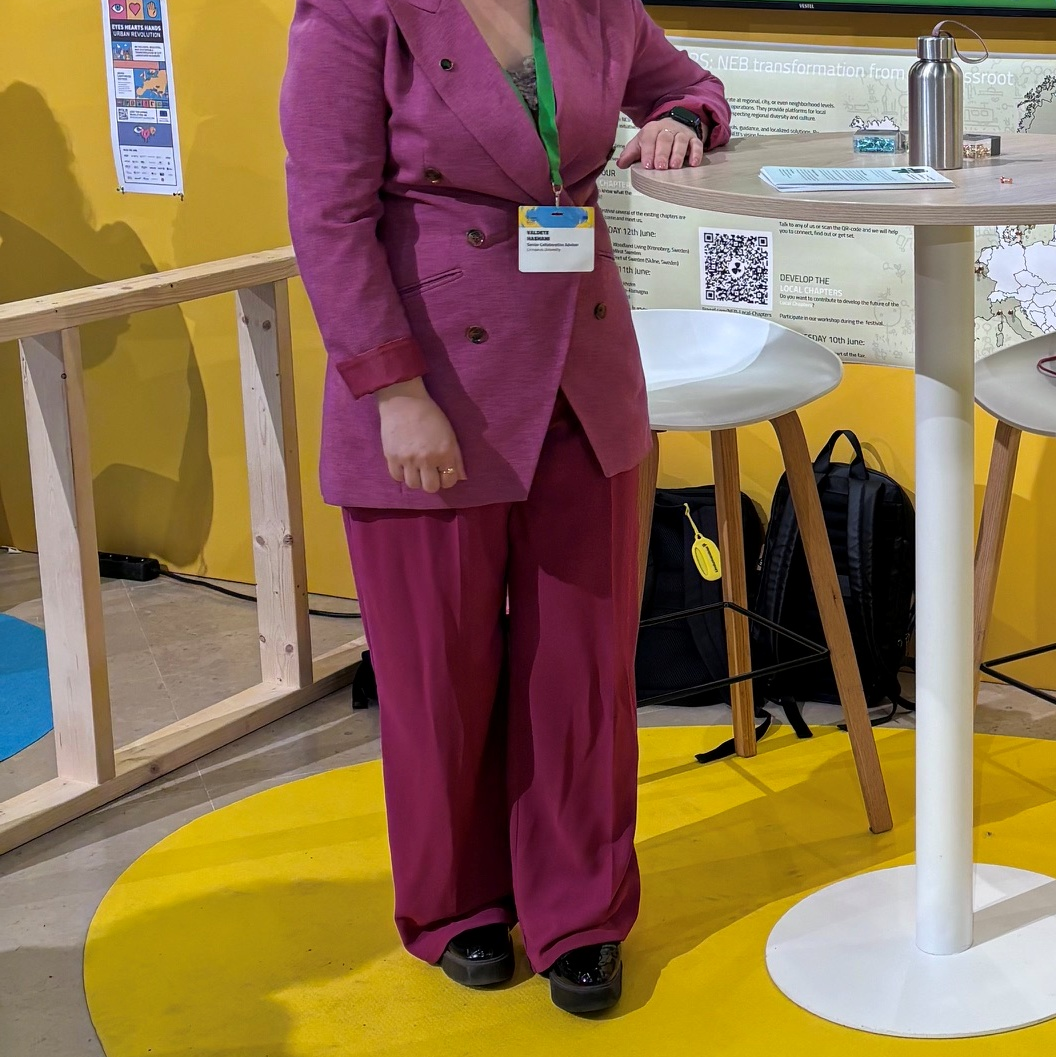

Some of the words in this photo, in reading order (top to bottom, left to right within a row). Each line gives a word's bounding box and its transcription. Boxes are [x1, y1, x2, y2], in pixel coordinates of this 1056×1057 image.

[718, 55, 748, 71] NEB
[753, 58, 866, 79] transformation
[869, 62, 905, 80] from
[756, 105, 768, 113] They
[768, 106, 785, 114] provide
[785, 107, 808, 115] platforms
[770, 113, 790, 121] diversity
[660, 212, 678, 220] chapters
[624, 227, 639, 236] 12th
[639, 229, 657, 238] June:
[634, 267, 651, 276] June:
[779, 273, 814, 284] DEVELOP
[816, 276, 830, 285] THE
[779, 285, 803, 294] LOCAL
[804, 286, 843, 297] CHAPTERS
[814, 296, 836, 304] contribute
[843, 298, 860, 307] develop
[779, 313, 804, 321] Participate
[817, 316, 840, 324] workshop
[841, 318, 856, 326] during
[829, 336, 845, 345] 10th
[847, 337, 865, 346] June:
